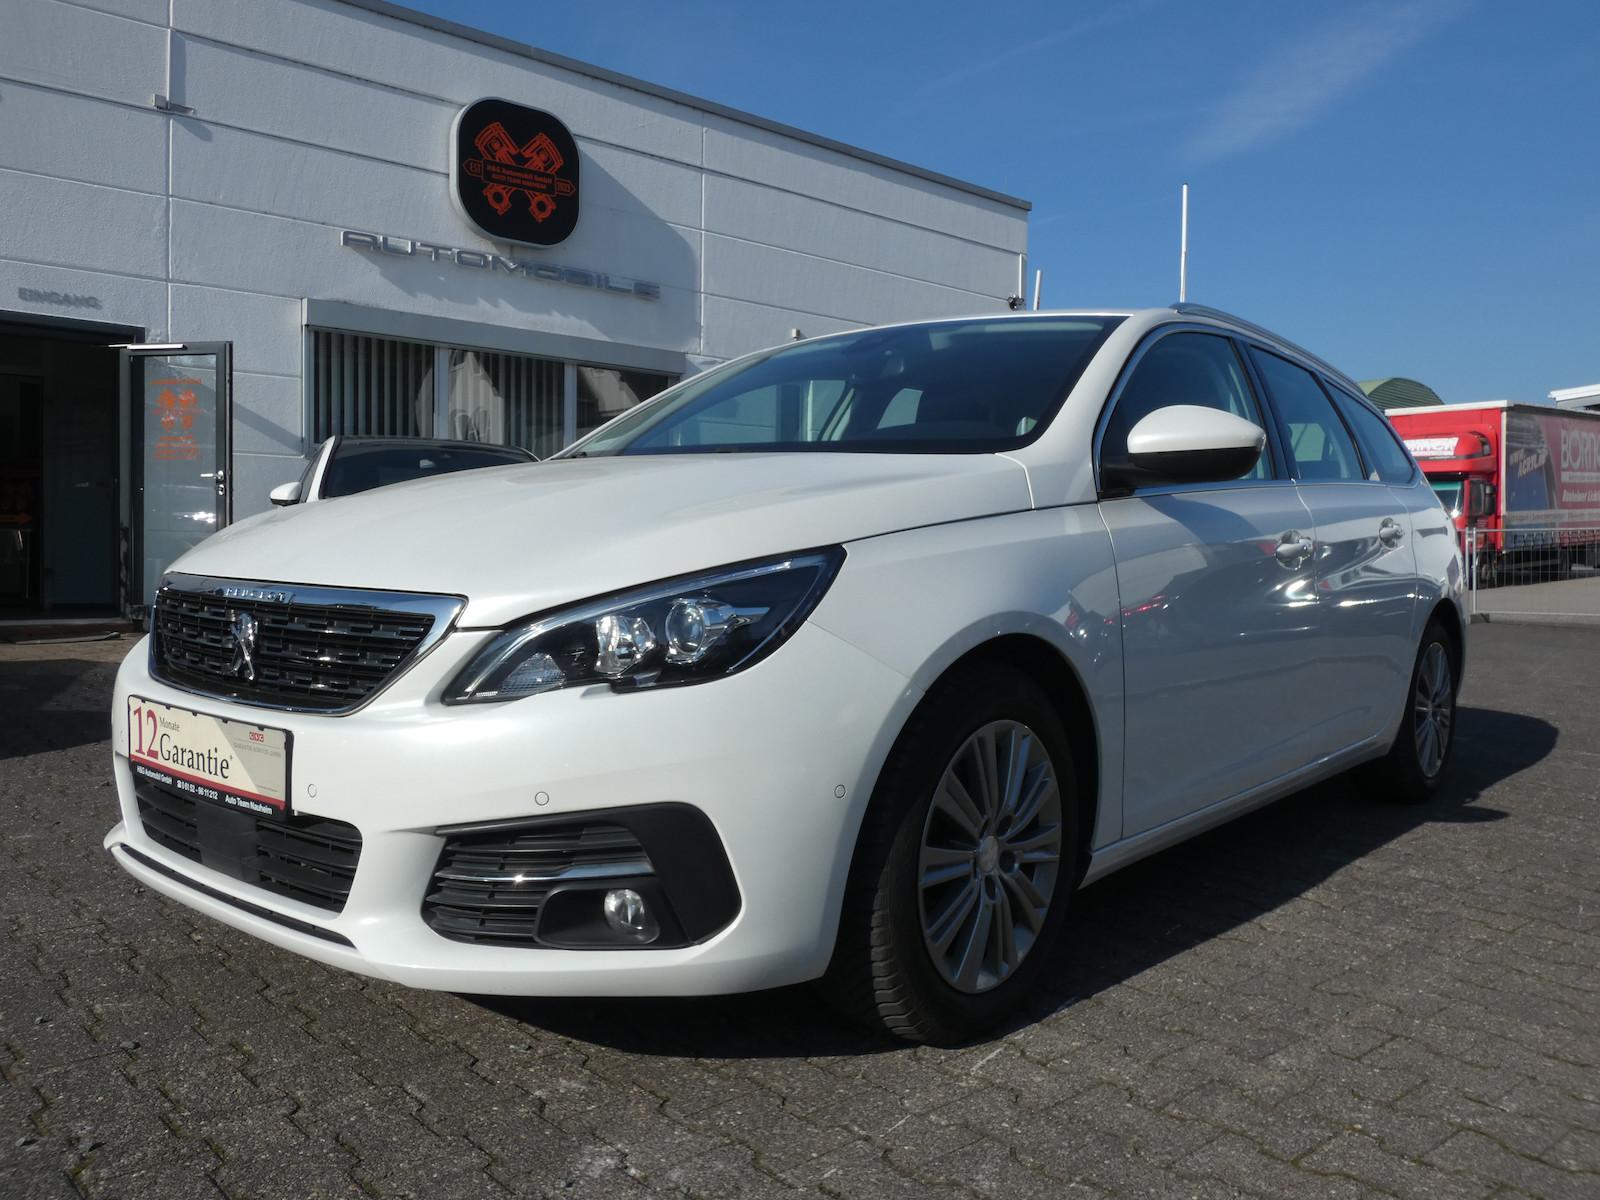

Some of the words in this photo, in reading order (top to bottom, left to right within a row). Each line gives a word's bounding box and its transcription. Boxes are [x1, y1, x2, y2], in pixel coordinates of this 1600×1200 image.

[340, 230, 661, 301] AUTOMOBILE
[133, 706, 158, 760] 12
[159, 717, 181, 732] Monate
